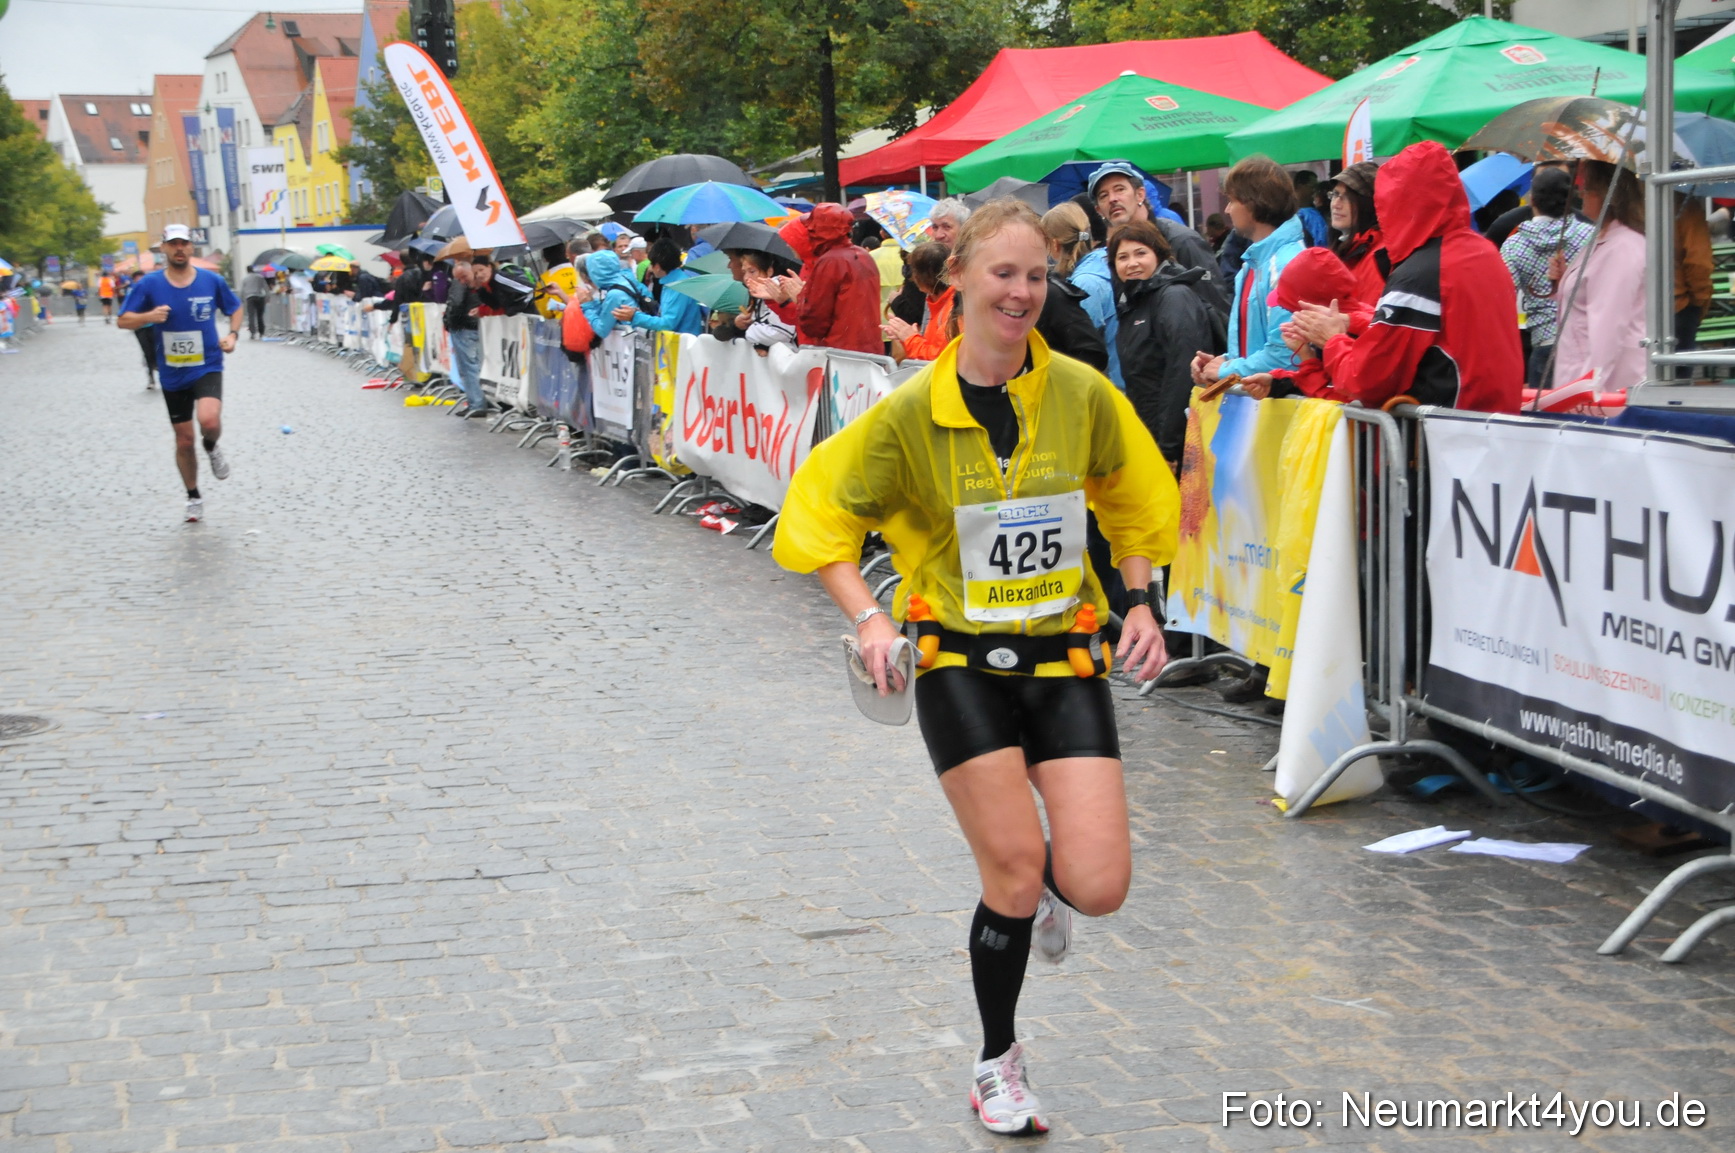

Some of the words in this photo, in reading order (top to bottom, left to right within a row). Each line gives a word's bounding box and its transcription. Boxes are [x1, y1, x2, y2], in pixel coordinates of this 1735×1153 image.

[171, 341, 195, 354] 452
[957, 460, 986, 476] LLC
[998, 503, 1050, 520] BOCK
[988, 527, 1063, 575] 425
[1452, 476, 1735, 628] NATHU
[988, 579, 1064, 603] Alexandra
[1601, 611, 1687, 660] MEDIA
[1454, 627, 1540, 667] INTERNETLÖSUNGEN
[1553, 653, 1662, 701] SCHULUNGSZENTRUM
[1668, 690, 1726, 719] KONZEPT
[1519, 709, 1684, 785] www.nathus-media.de
